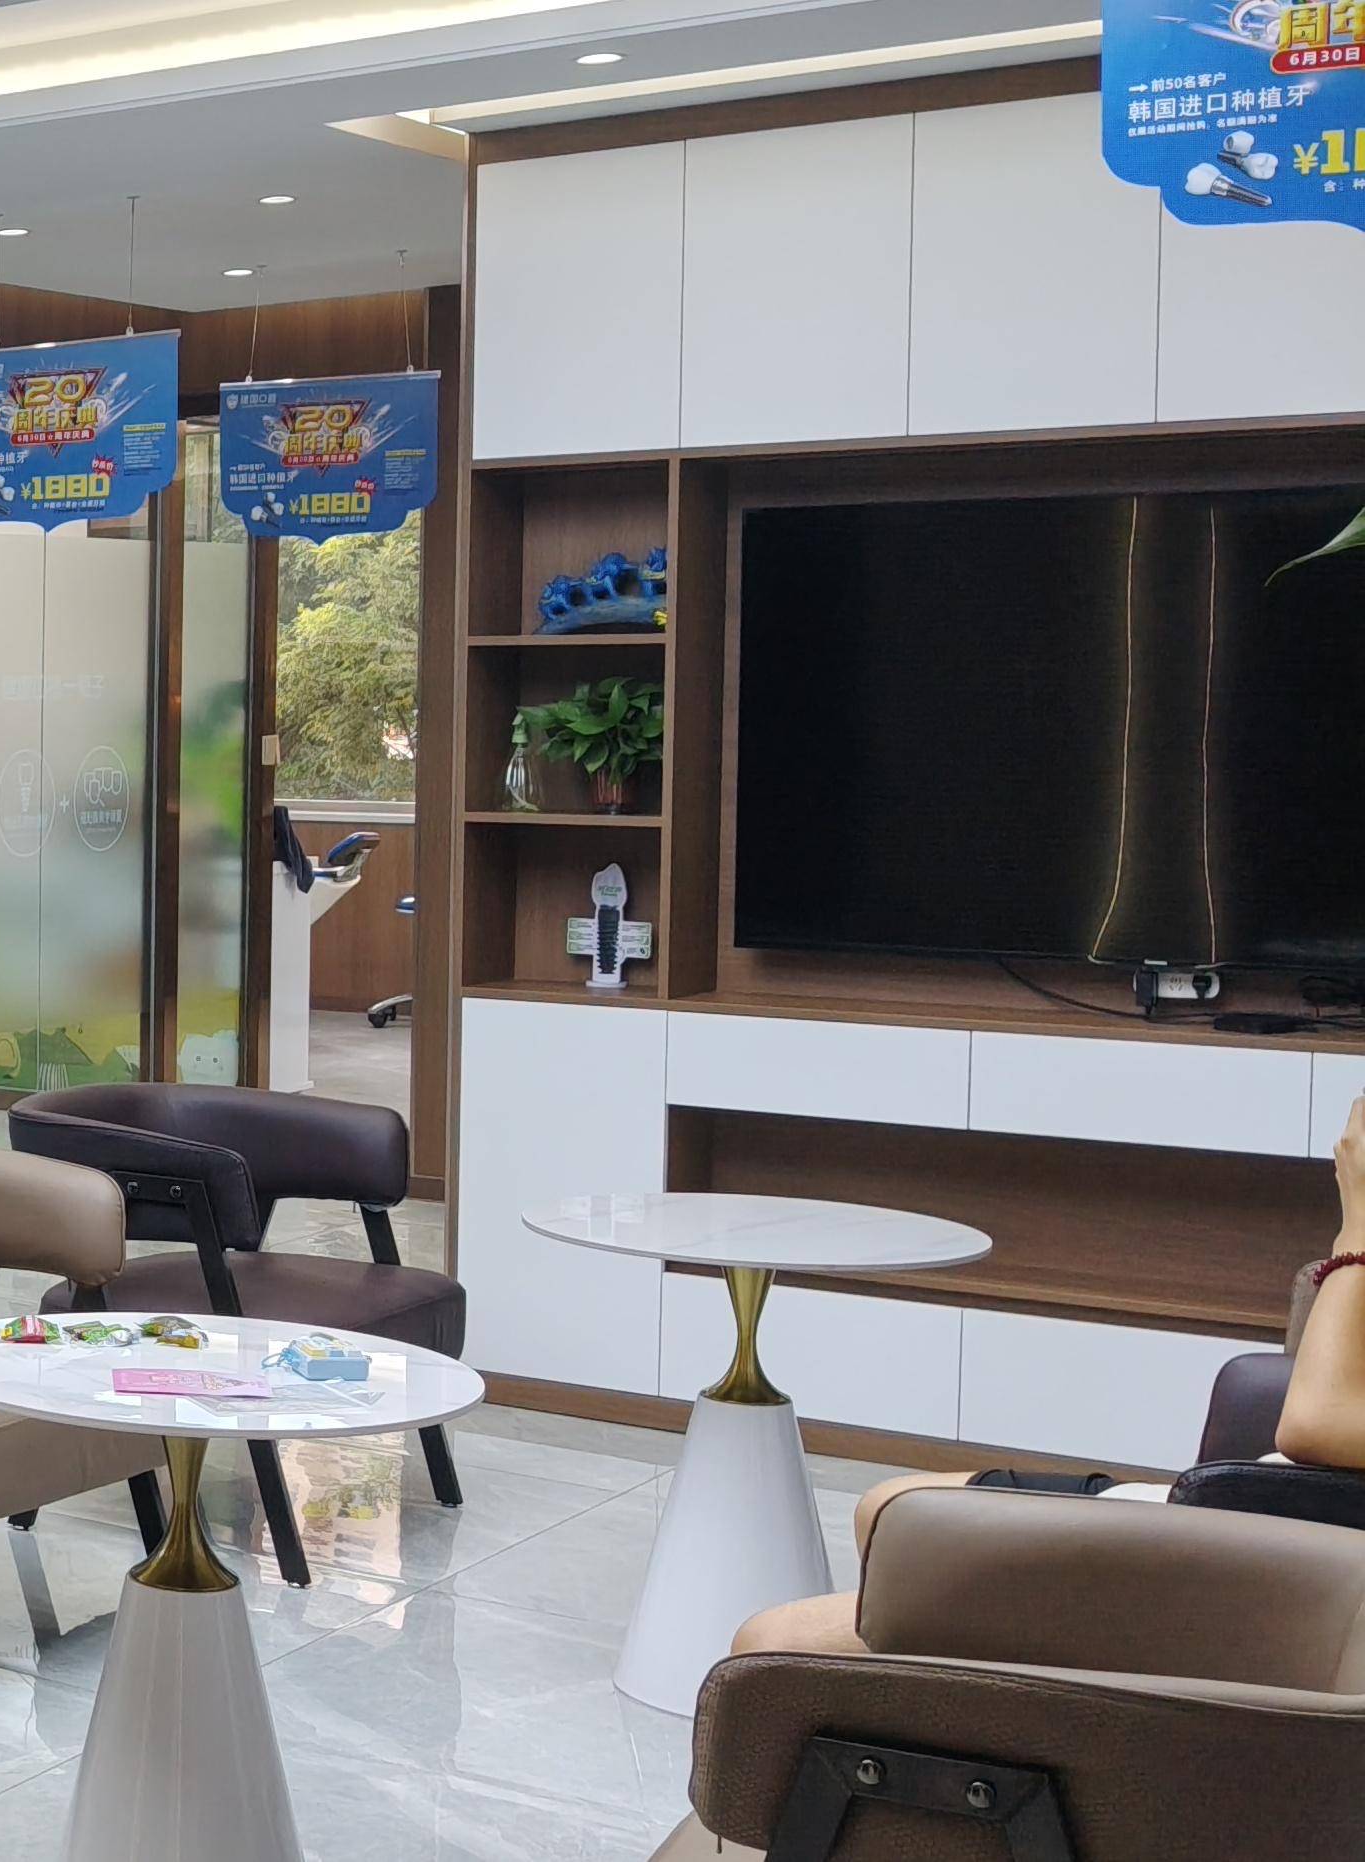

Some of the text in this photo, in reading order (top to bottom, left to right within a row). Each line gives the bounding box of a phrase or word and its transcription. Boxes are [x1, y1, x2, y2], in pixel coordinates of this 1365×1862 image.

[1290, 47, 1360, 66] 6月30日
[1151, 72, 1226, 93] 前50名客户
[1128, 85, 1310, 123] 韩国进口种植牙
[1293, 129, 1365, 174] ¥1
[23, 374, 86, 407] 20
[294, 405, 352, 432] 20
[21, 473, 110, 500] ¥1880
[289, 492, 371, 515] ¥1880
